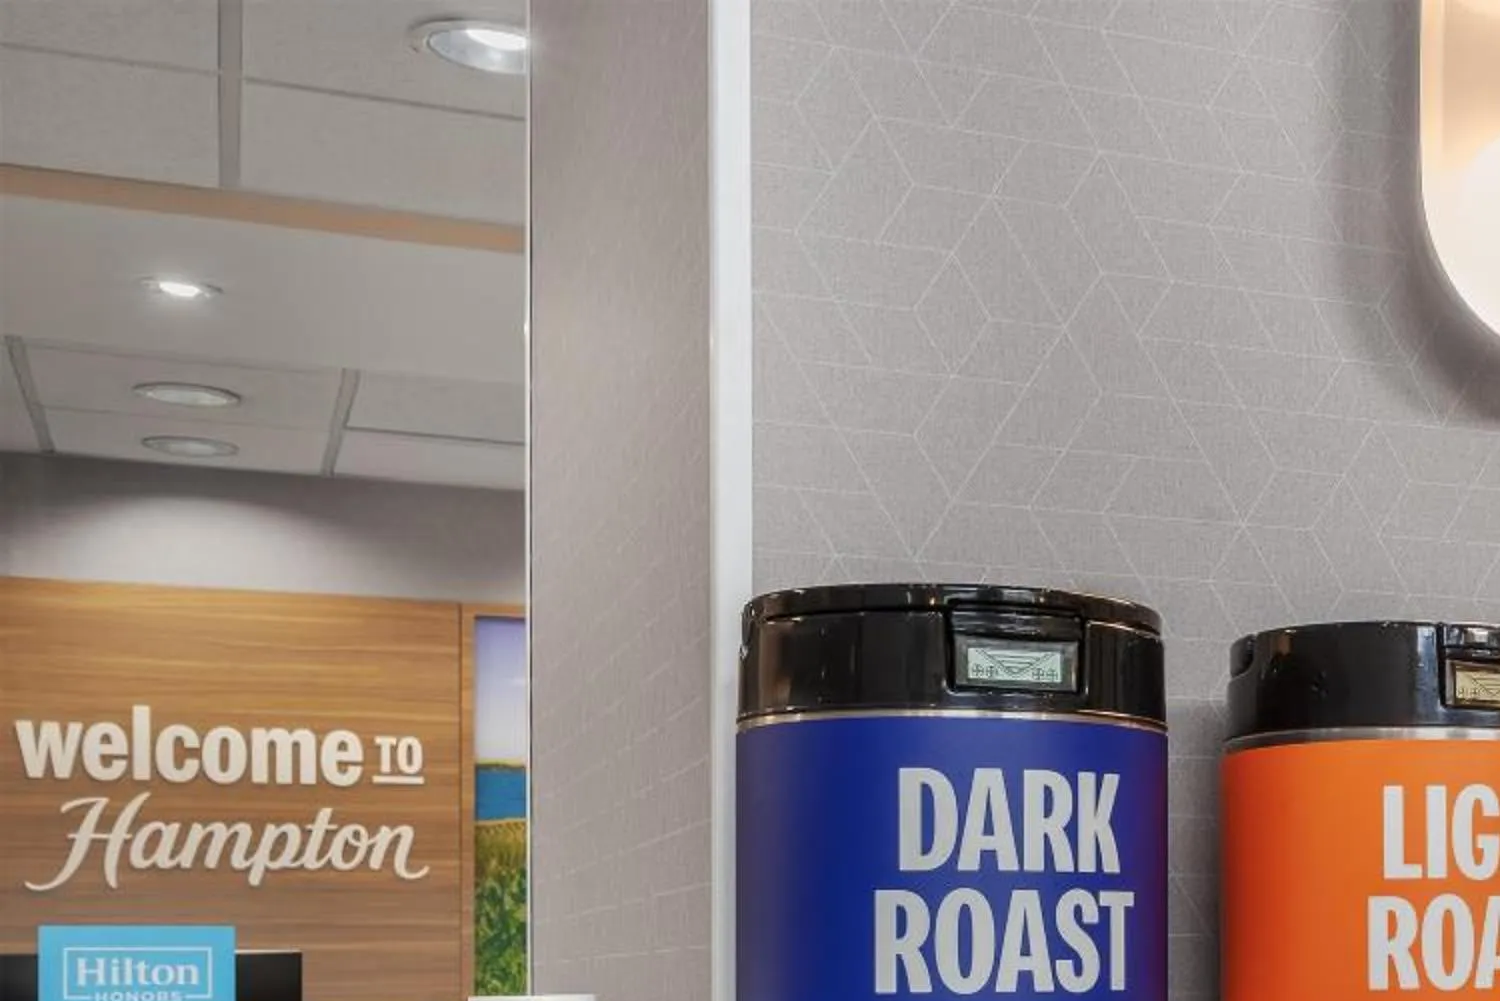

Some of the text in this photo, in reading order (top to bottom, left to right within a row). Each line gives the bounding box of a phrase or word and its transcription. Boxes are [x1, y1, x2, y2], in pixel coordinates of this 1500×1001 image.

[13, 704, 425, 786] welcome TO
[24, 791, 430, 892] Hampton
[898, 767, 1121, 874] DARK
[75, 957, 200, 987] Hilton
[874, 889, 1135, 994] ROAST
